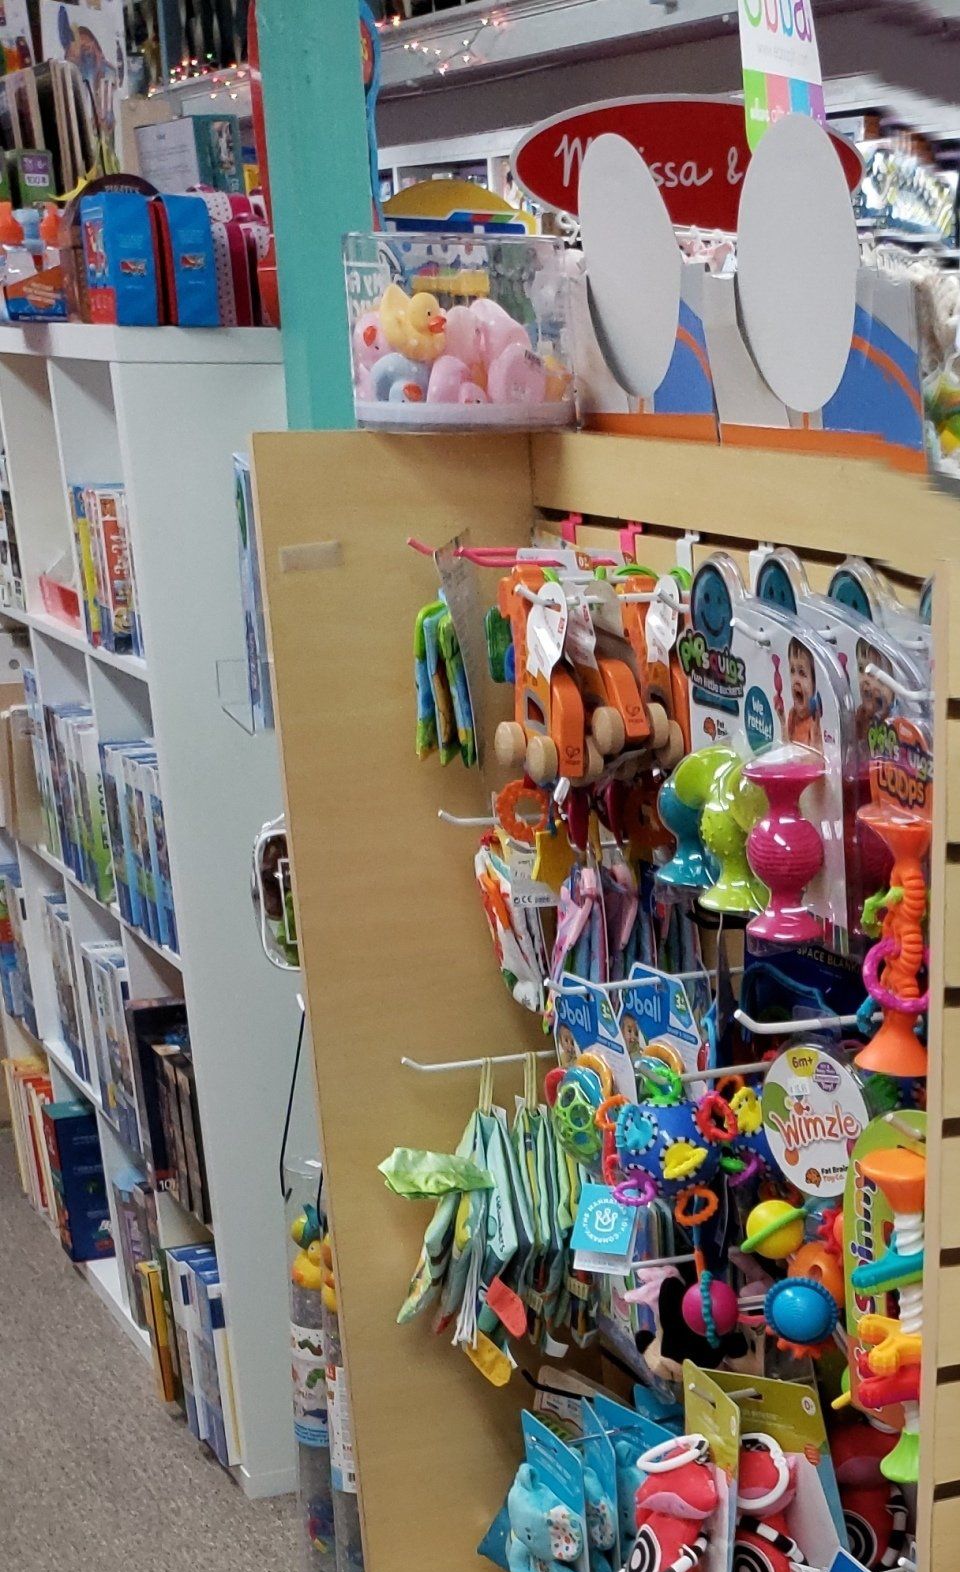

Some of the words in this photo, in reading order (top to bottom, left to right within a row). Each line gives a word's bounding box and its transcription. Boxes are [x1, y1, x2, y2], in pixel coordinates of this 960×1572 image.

[726, 146, 743, 185] &
[797, 946, 825, 963] SPACE
[792, 1056, 813, 1069] 6m+
[770, 1102, 860, 1149] Wimzle
